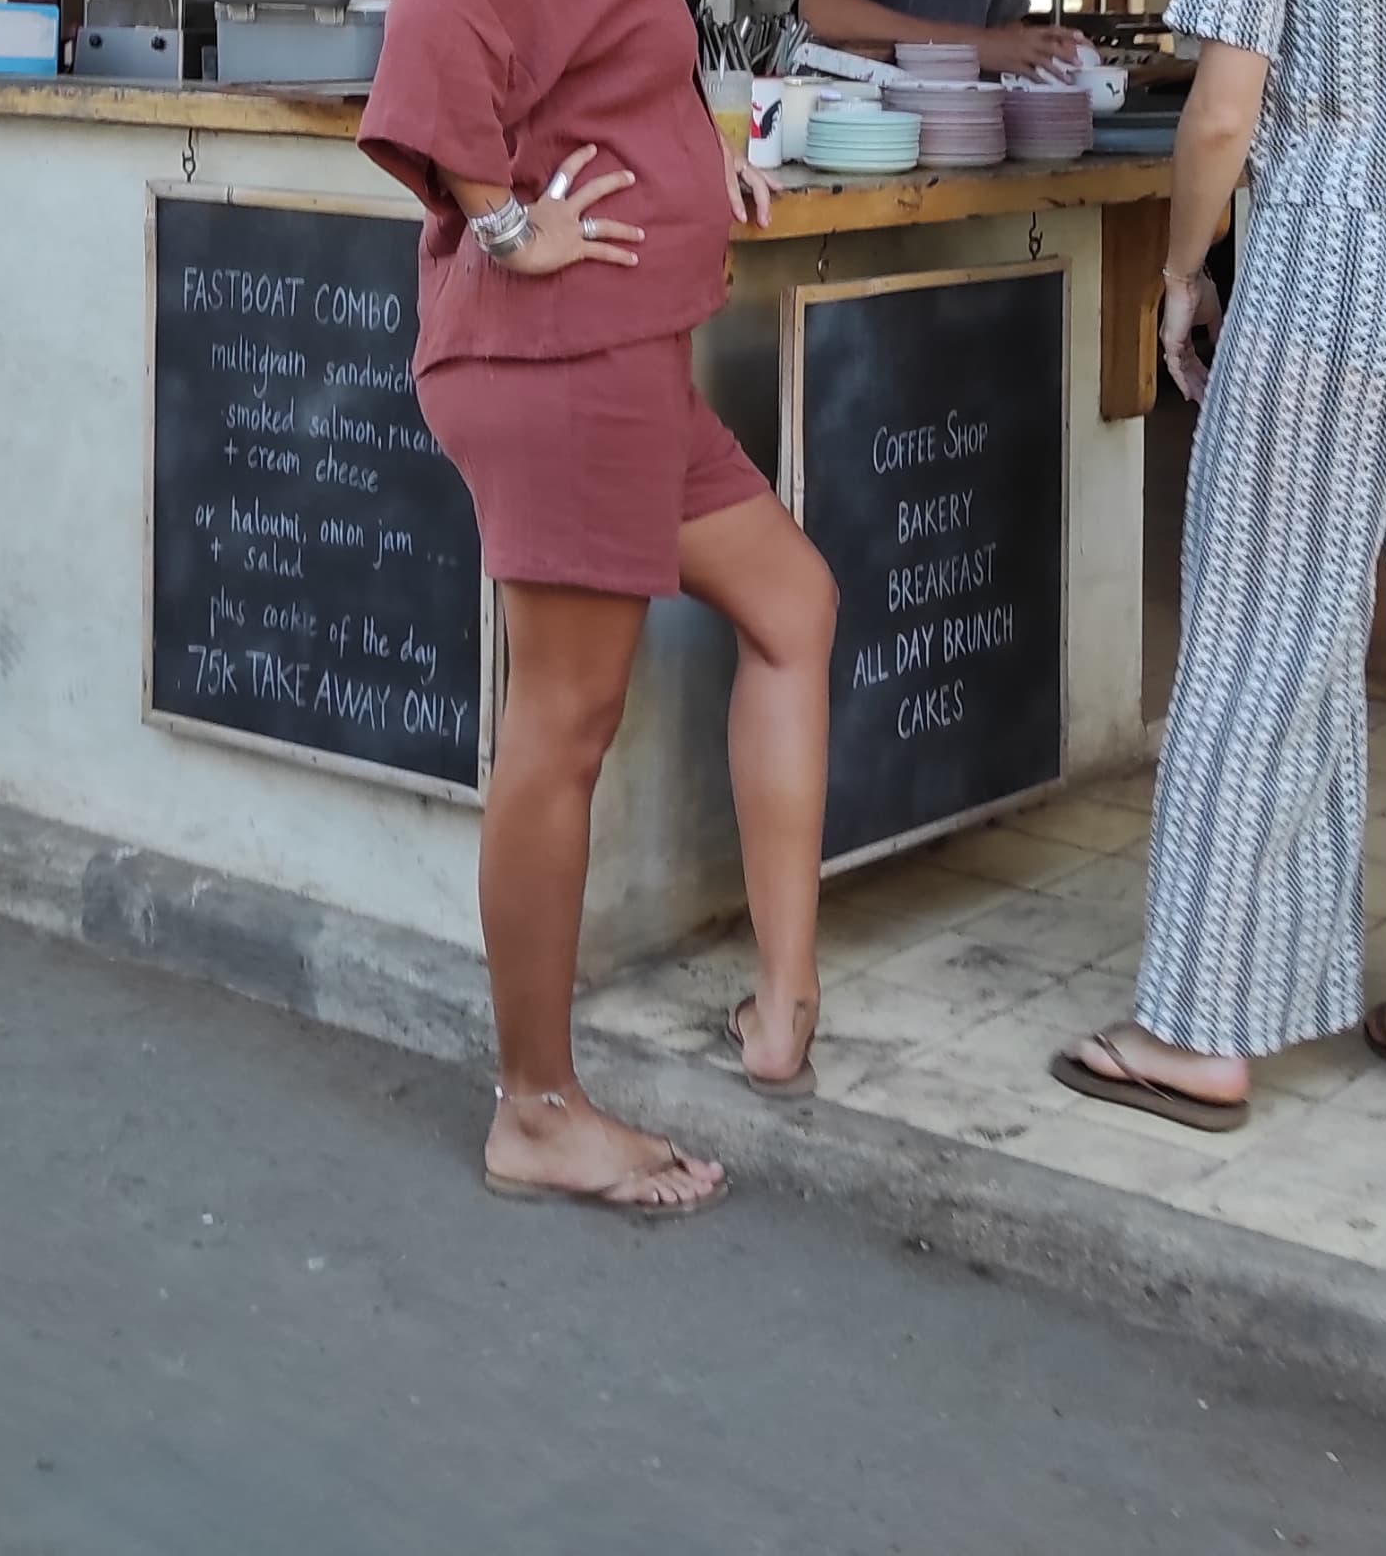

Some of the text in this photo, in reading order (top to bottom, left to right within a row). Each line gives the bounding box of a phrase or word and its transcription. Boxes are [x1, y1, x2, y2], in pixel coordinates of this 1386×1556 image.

[183, 267, 401, 333] FASTBOAT COMBO
[211, 333, 306, 399] multigrain
[225, 396, 295, 436] smoked
[247, 445, 301, 476] cream
[315, 444, 379, 493] cheese
[195, 503, 215, 530] or
[320, 518, 365, 548] onion
[372, 519, 414, 571] jam
[898, 488, 974, 545] BAKERY
[243, 541, 305, 578] salad
[888, 541, 997, 614] BREAKFAST
[210, 585, 246, 639] plus
[329, 614, 352, 659] of
[363, 615, 390, 658] the
[399, 623, 438, 687] day
[852, 603, 1015, 690] ALL DAY BRUNCH
[245, 649, 311, 708] TAKE
[313, 669, 392, 732] AWAY
[403, 689, 469, 747] ONLY
[897, 678, 965, 741] CAKES
